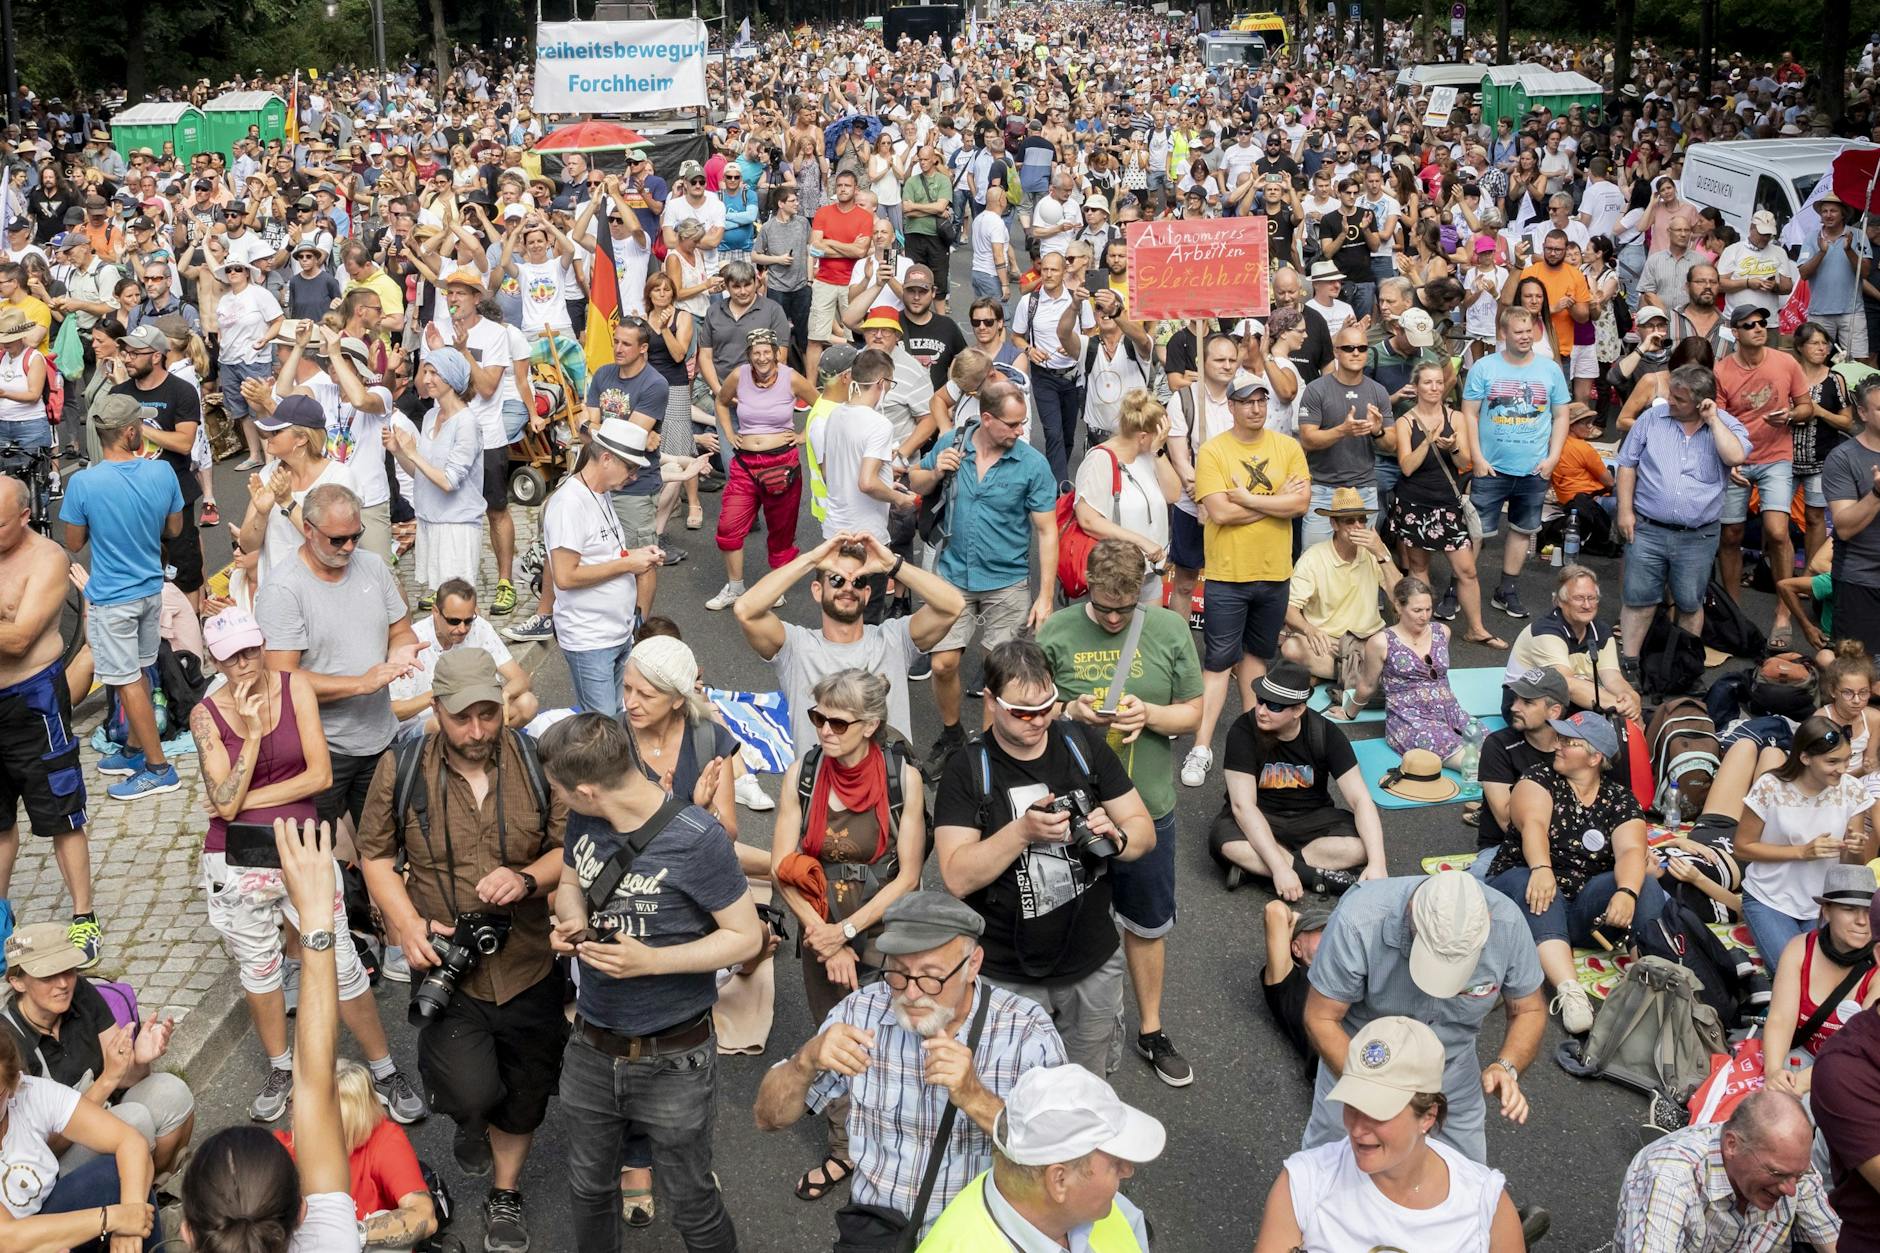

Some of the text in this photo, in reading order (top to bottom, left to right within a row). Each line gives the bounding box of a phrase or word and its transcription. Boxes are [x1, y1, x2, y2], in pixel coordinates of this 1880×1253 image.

[536, 40, 705, 62] reiheitsbewegu
[569, 74, 673, 92] Forchheim
[1696, 175, 1734, 199] QUERDENKEN
[1166, 242, 1246, 264] Arbeiten
[1138, 261, 1265, 289] Gleichheit
[1074, 648, 1142, 664] SEPULTA
[1074, 660, 1144, 681] ROOS
[573, 834, 669, 897] Glenood
[635, 902, 659, 913] WAP
[1021, 893, 1036, 920] WEST
